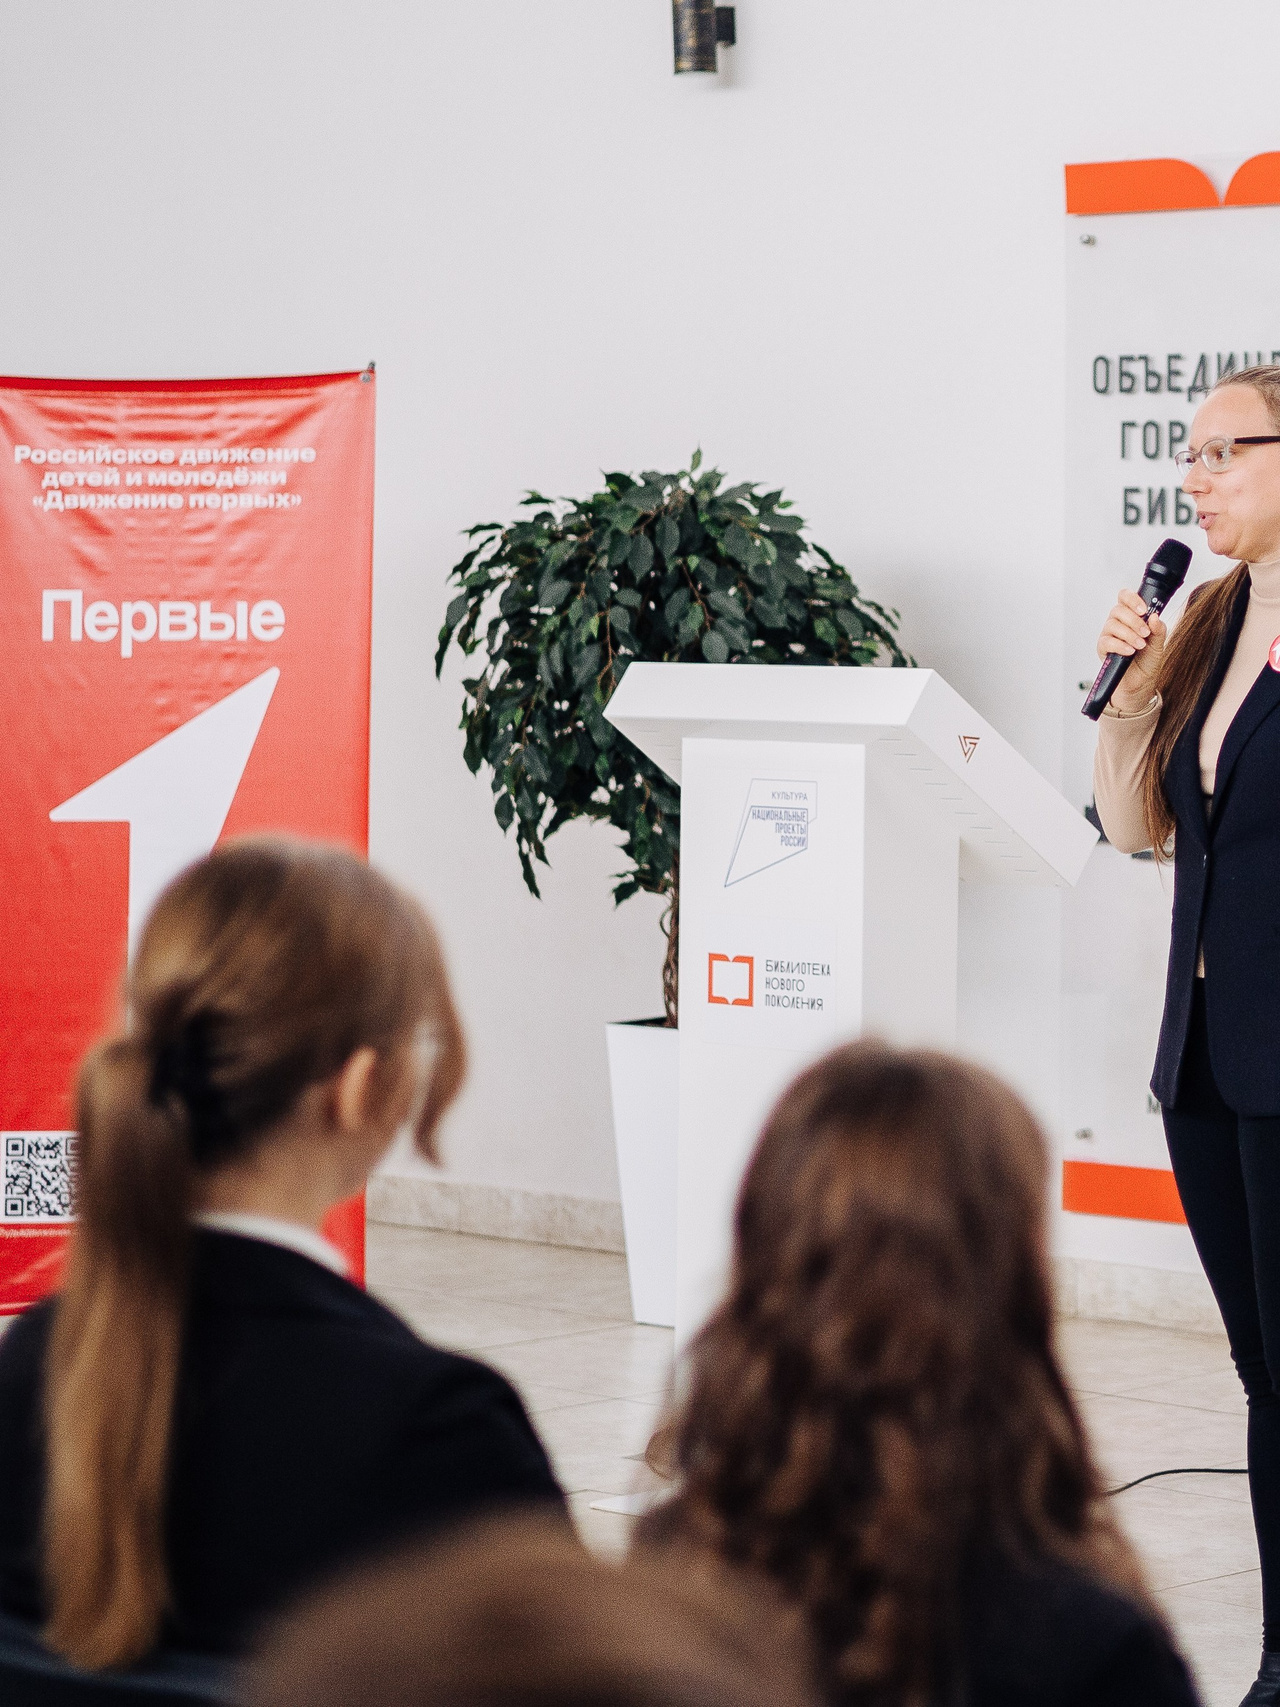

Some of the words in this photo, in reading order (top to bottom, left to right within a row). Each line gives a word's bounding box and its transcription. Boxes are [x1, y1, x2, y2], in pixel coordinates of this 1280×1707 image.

[14, 444, 176, 464] Российское
[179, 446, 317, 466] движение
[41, 467, 121, 488] детей
[126, 471, 143, 486] и
[148, 467, 287, 488] молодёжи
[32, 490, 184, 512] «Движение
[189, 493, 303, 512] первых»
[41, 589, 286, 658] Первые
[771, 791, 808, 801] КУЛЬТУРА
[752, 809, 806, 822] НАЦИОНАЛЬНЫЕ
[775, 822, 807, 835] ПРОЕКТЫ
[780, 835, 807, 847] РОССИИ
[765, 959, 831, 976] БИБЛИОТЕКА
[765, 977, 805, 992] НОВОГО
[765, 994, 824, 1011] ПОКОЛЕНИЯ
